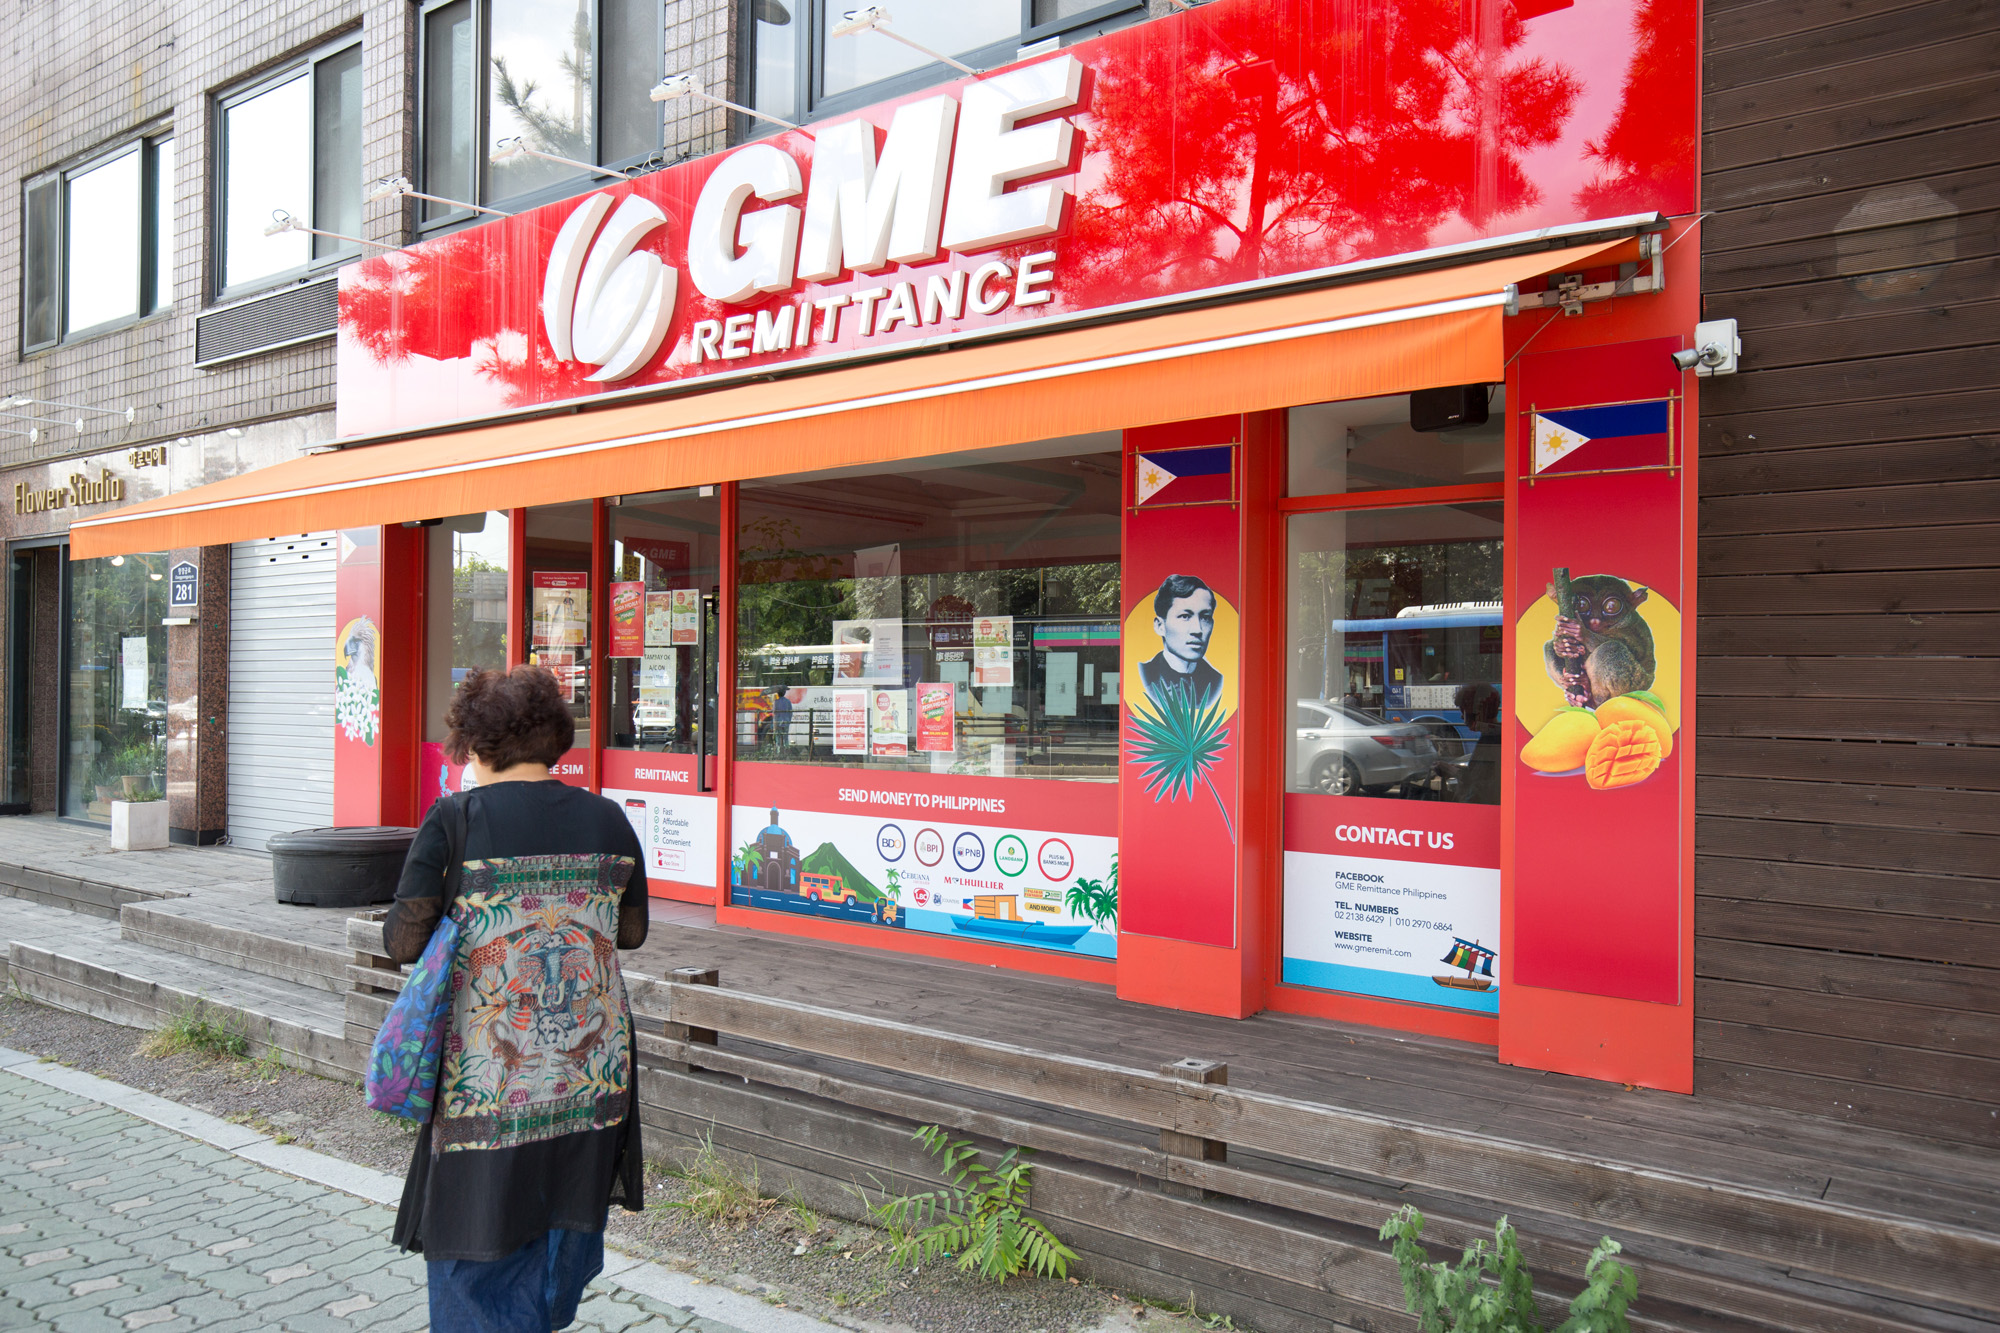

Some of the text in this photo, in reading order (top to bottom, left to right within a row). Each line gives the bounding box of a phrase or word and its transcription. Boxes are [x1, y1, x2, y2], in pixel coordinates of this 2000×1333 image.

[687, 53, 1085, 303] GME
[690, 251, 1057, 363] REMITTANCE
[128, 446, 166, 469] 마로니에
[15, 468, 125, 514] Flower Studio
[650, 548, 676, 560] GME
[176, 584, 192, 600] 281
[562, 764, 584, 774] SIM
[635, 768, 688, 782] REMITTANCE
[838, 788, 1006, 813] SEND MONEY TO PHILIPPINES
[662, 818, 689, 827] Affordable
[662, 827, 679, 836] Secure
[1335, 825, 1454, 850] CONTACT US
[662, 837, 691, 847] Convenient
[882, 838, 901, 849] BDO
[927, 844, 938, 852] BPI
[965, 848, 981, 857] PNB
[1335, 871, 1384, 884] FACEBOOK
[1335, 881, 1447, 900] GME Remittance Philippines
[1335, 901, 1399, 915] TEL. NUMBERS
[1334, 910, 1453, 931] 02 2138 6429 010 2970 6864
[1334, 930, 1372, 942] WEBSITE
[1334, 941, 1412, 958] www.gmeremit.com
